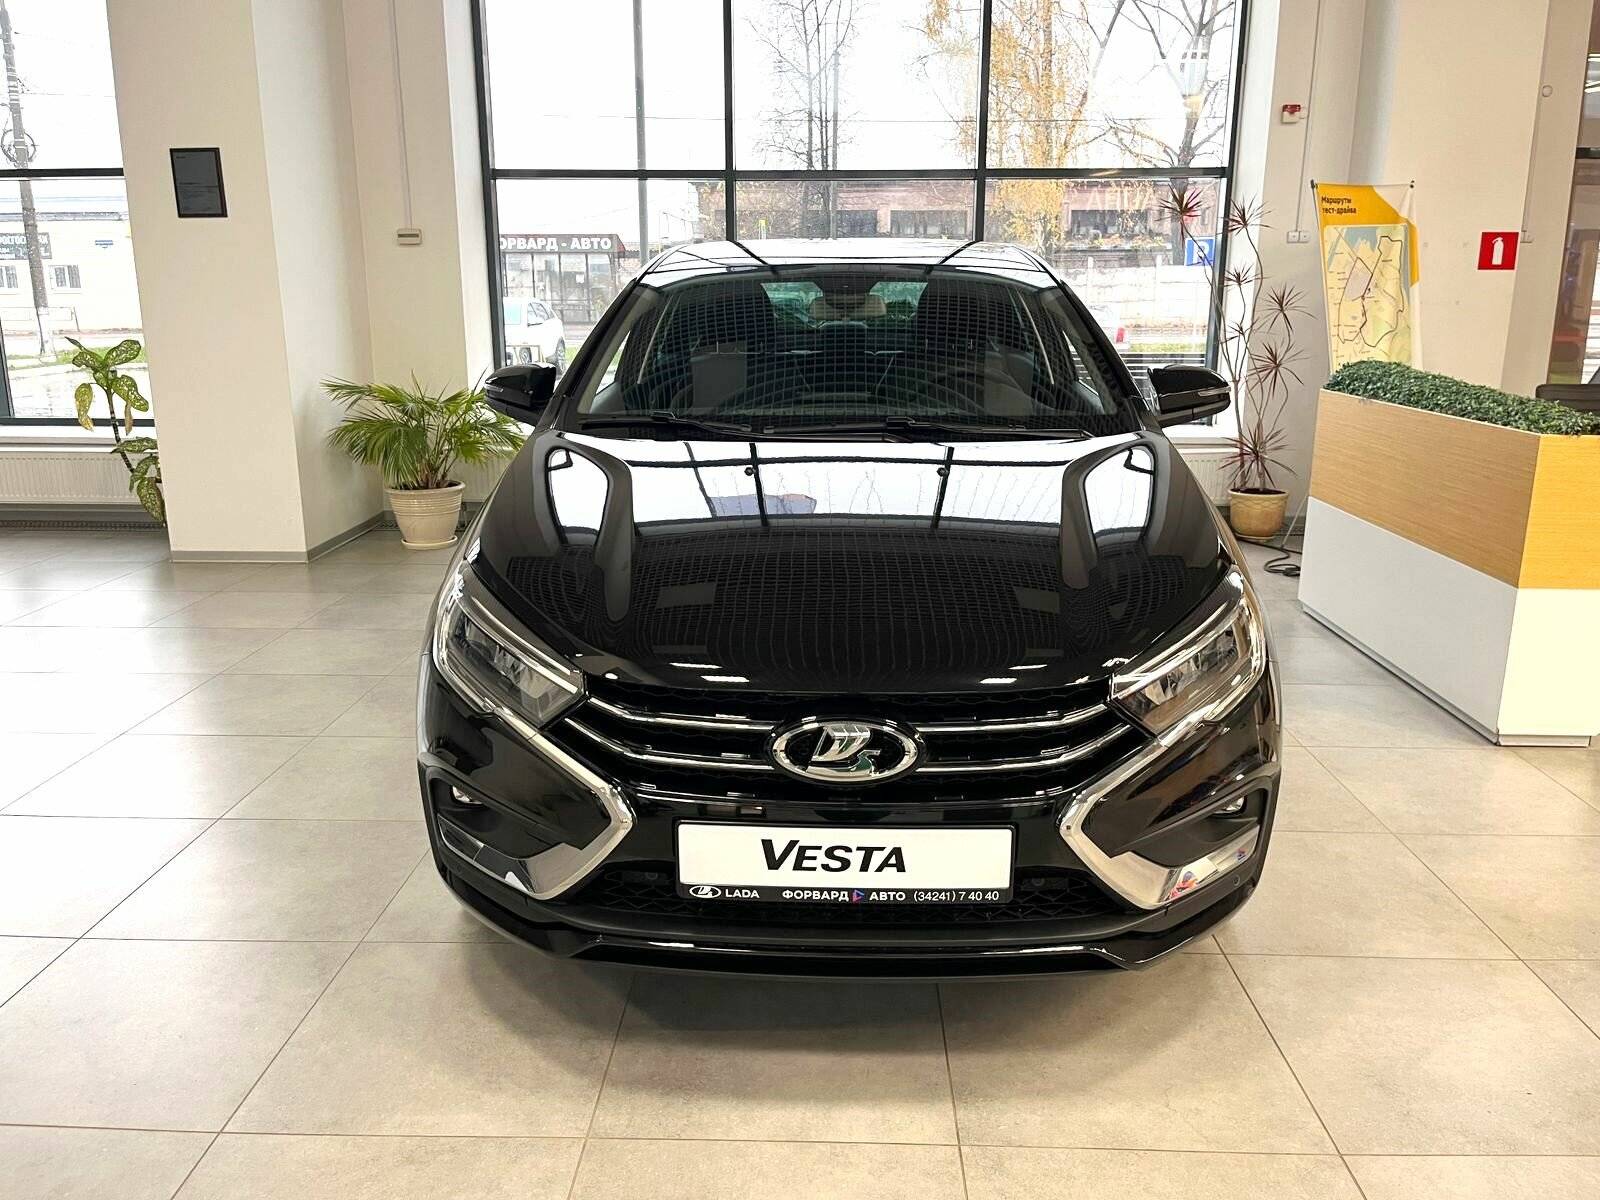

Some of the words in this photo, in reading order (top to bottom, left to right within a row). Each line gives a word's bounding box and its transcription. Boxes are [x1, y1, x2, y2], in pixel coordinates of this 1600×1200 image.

[570, 237, 612, 250] АВТО
[761, 838, 907, 873] VESTA
[725, 888, 760, 899] LADA
[782, 889, 850, 902] ФОРВАРД
[869, 891, 906, 901] АВТО
[913, 890, 956, 902] (34241)
[958, 891, 967, 901] 7
[968, 891, 982, 901] 40
[984, 891, 1000, 901] 40
